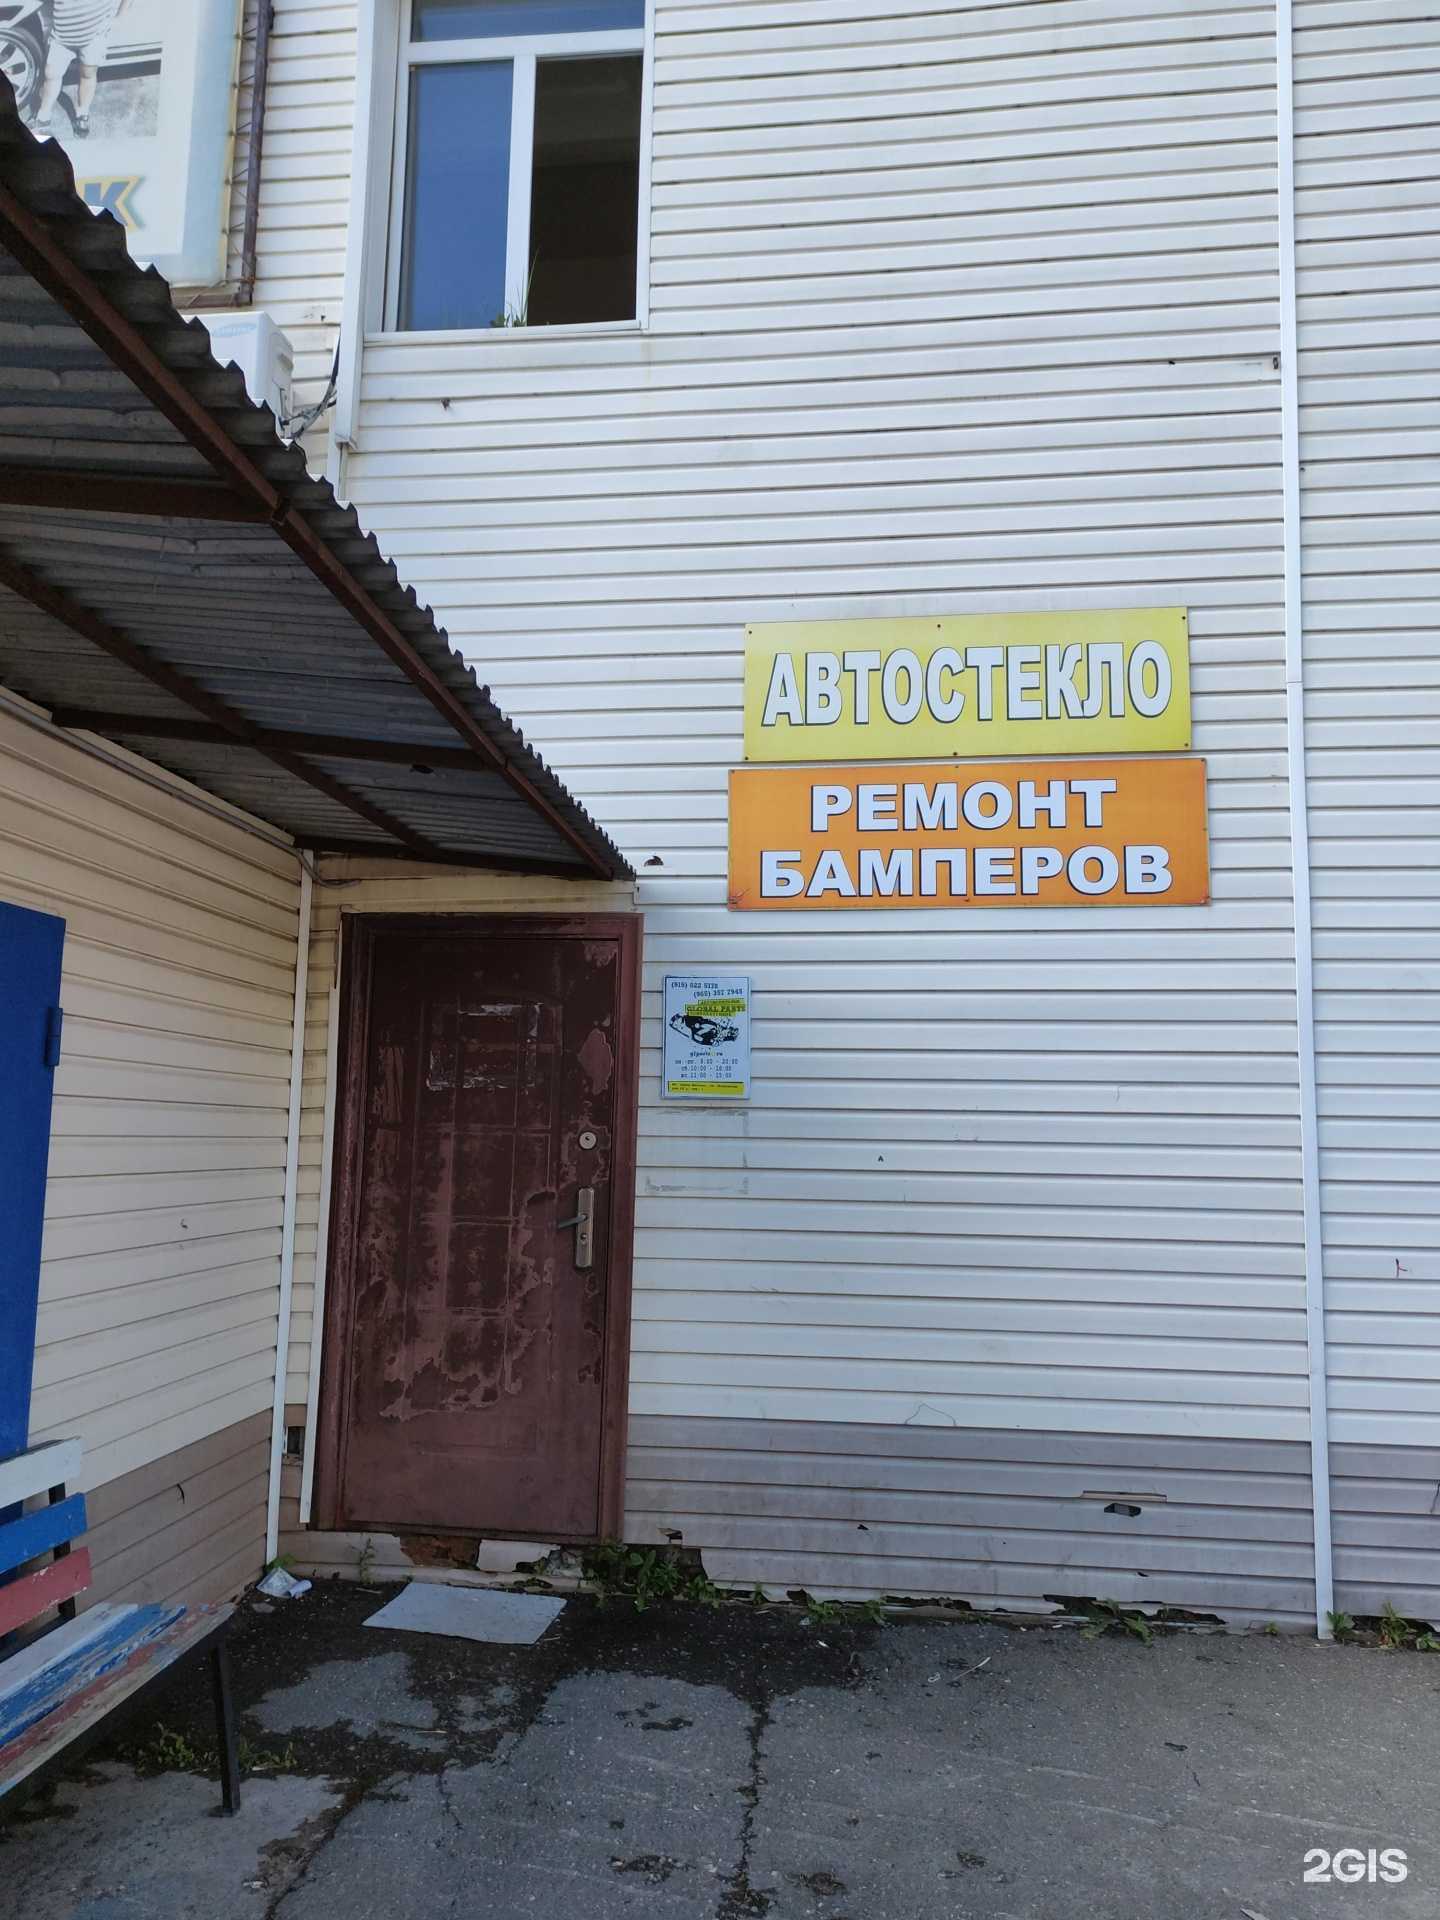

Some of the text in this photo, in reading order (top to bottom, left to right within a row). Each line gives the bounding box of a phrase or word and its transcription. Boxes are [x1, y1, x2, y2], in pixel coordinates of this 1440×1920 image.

[761, 640, 1173, 726] АВТОСТЕКЛО
[810, 779, 1118, 832] РЕМОНТ
[760, 844, 1174, 898] БАМПЕРОВ
